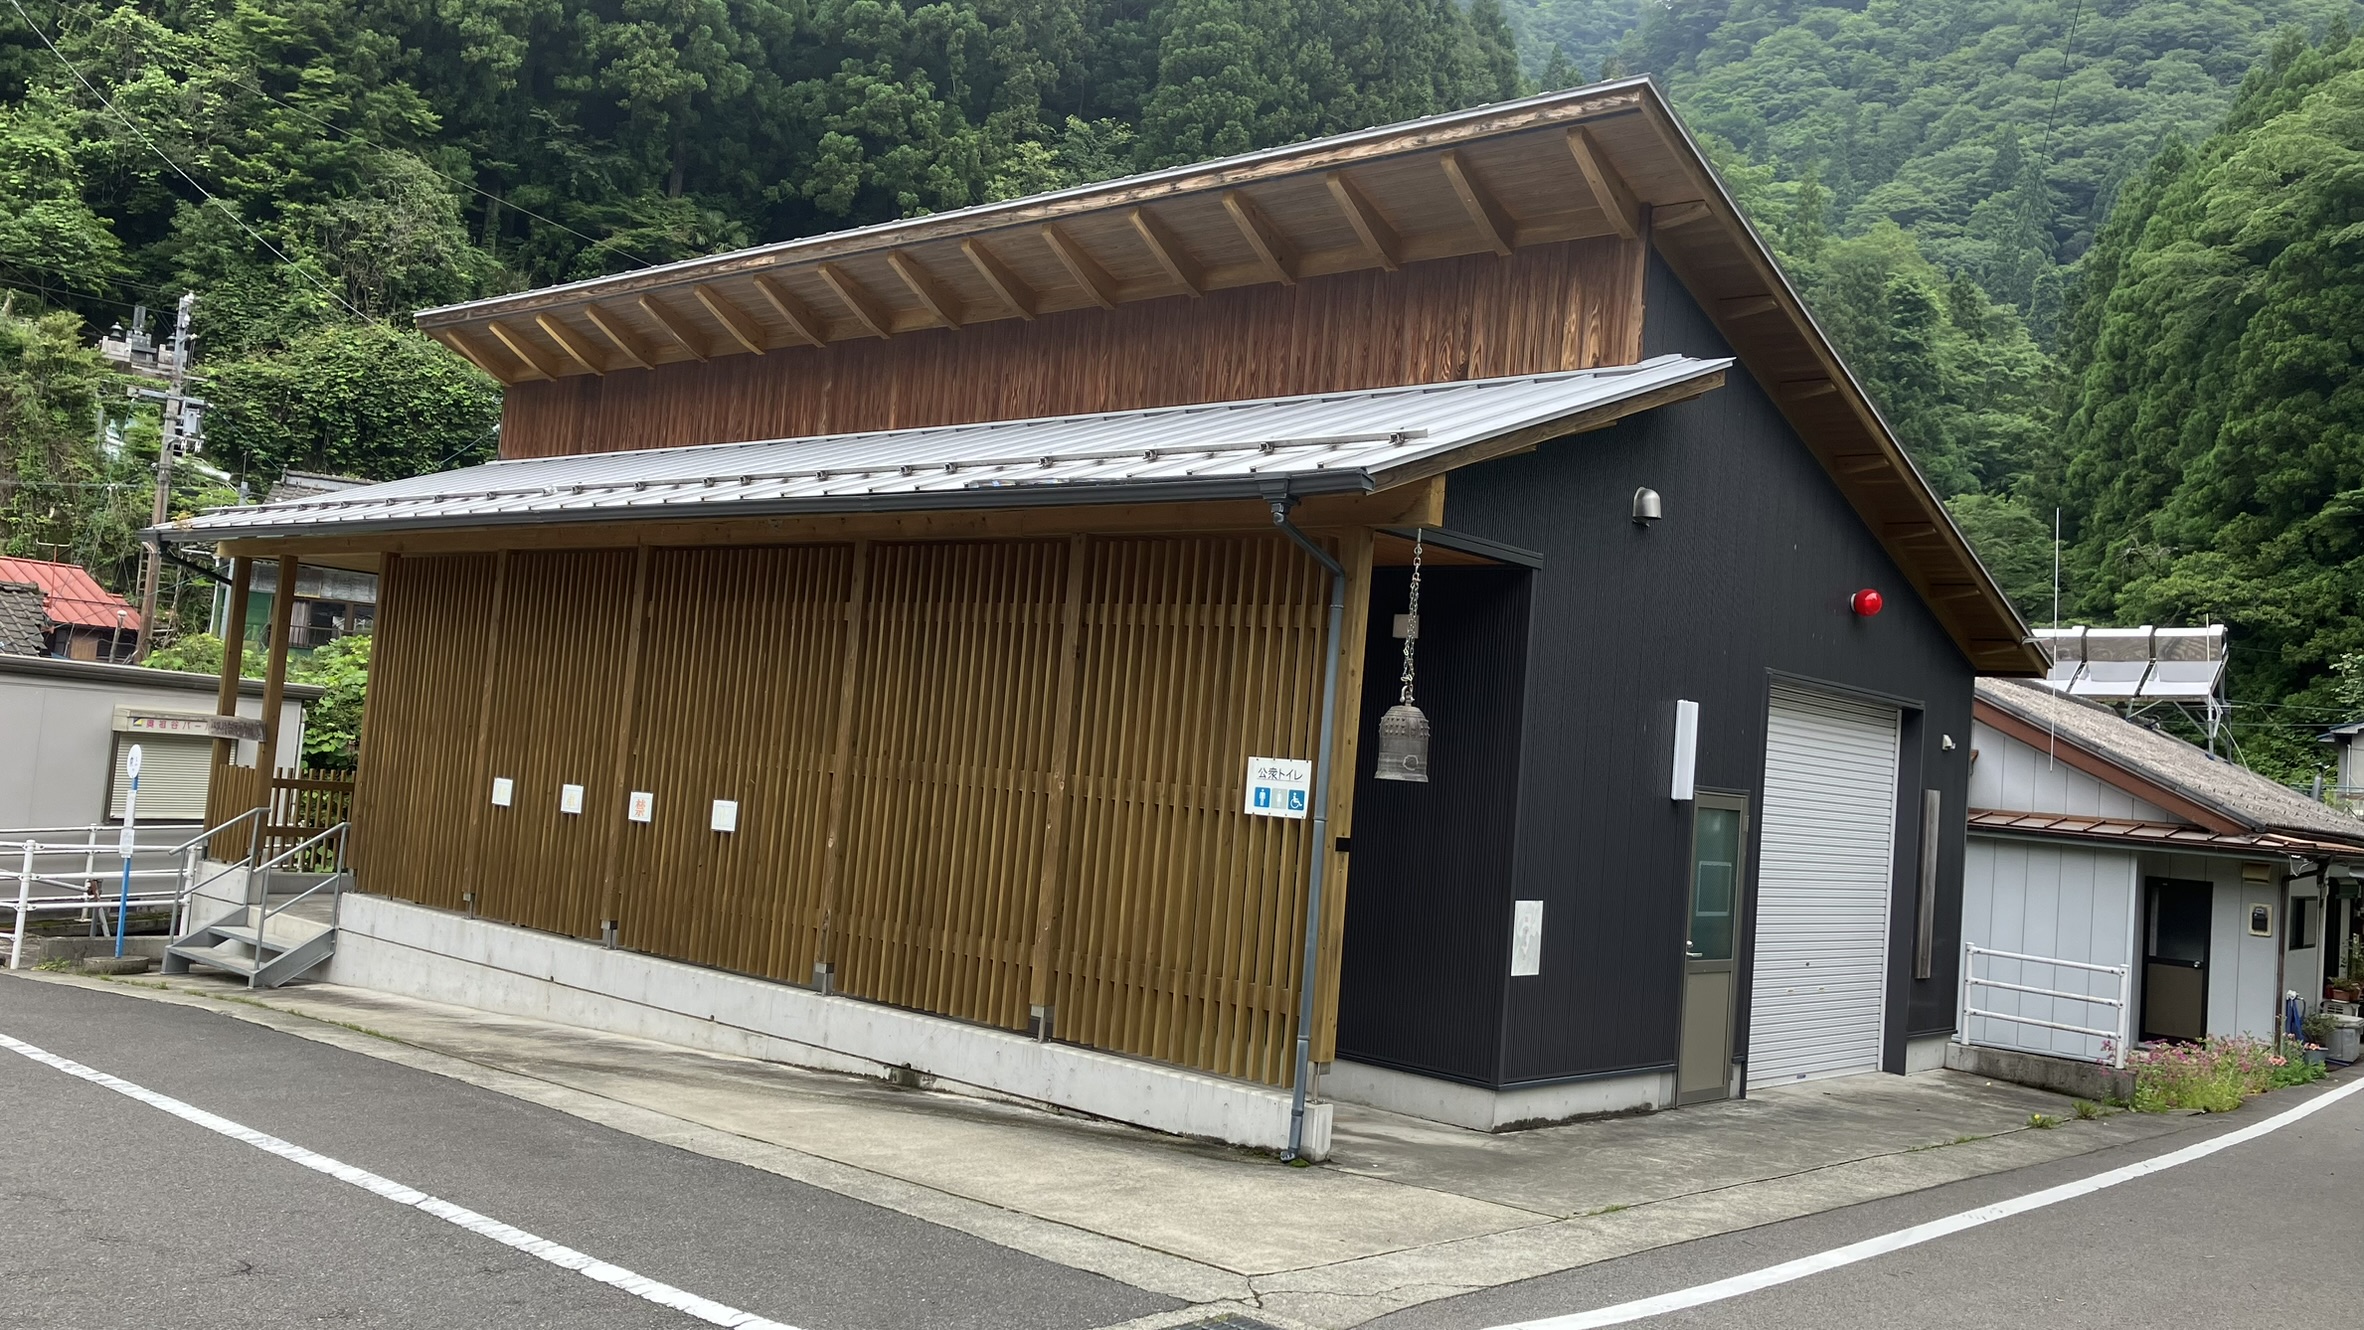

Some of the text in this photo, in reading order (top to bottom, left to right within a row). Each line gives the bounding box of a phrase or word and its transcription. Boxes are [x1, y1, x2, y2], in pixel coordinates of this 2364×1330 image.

[1258, 767, 1303, 780] 公衆トイレ
[635, 798, 646, 817] 禁
